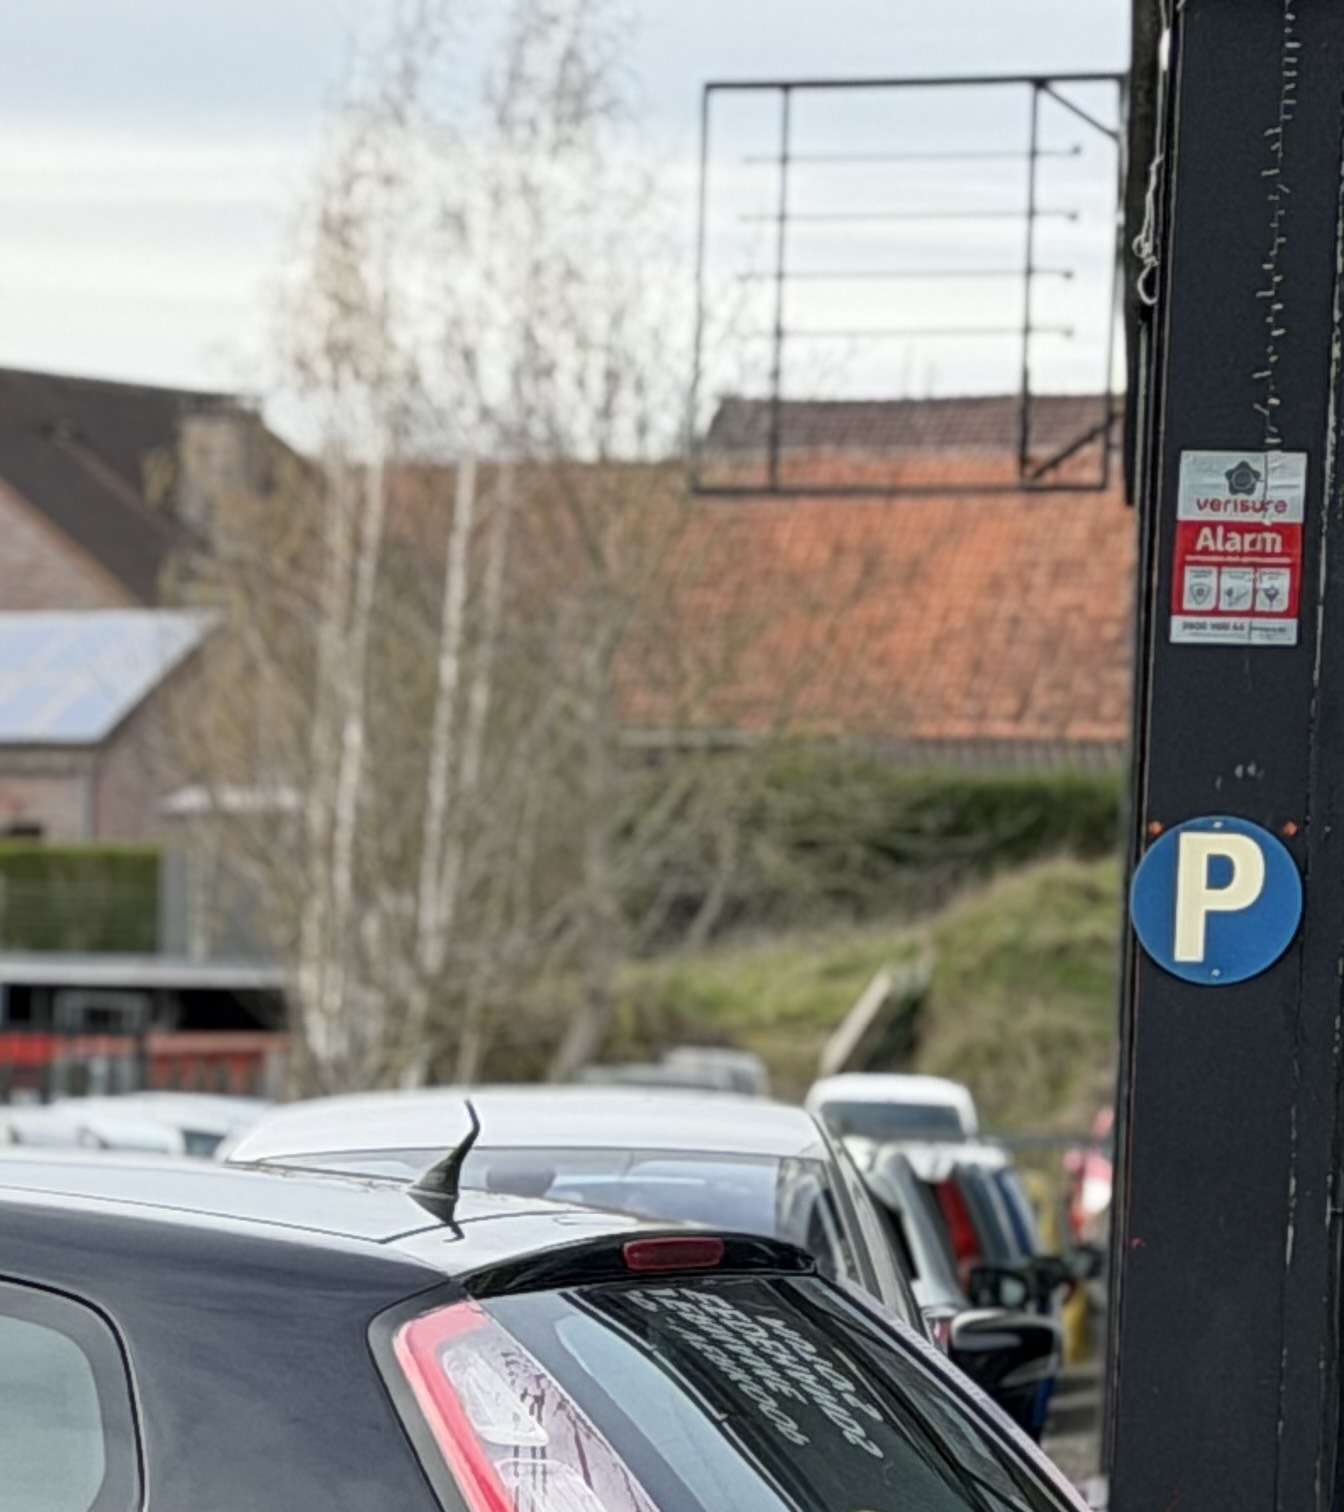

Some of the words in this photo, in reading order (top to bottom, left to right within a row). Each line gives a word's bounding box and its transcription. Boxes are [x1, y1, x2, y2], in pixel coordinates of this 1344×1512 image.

[1196, 497, 1288, 514] verisure
[1195, 524, 1283, 555] Alarm
[1174, 831, 1265, 962] P
